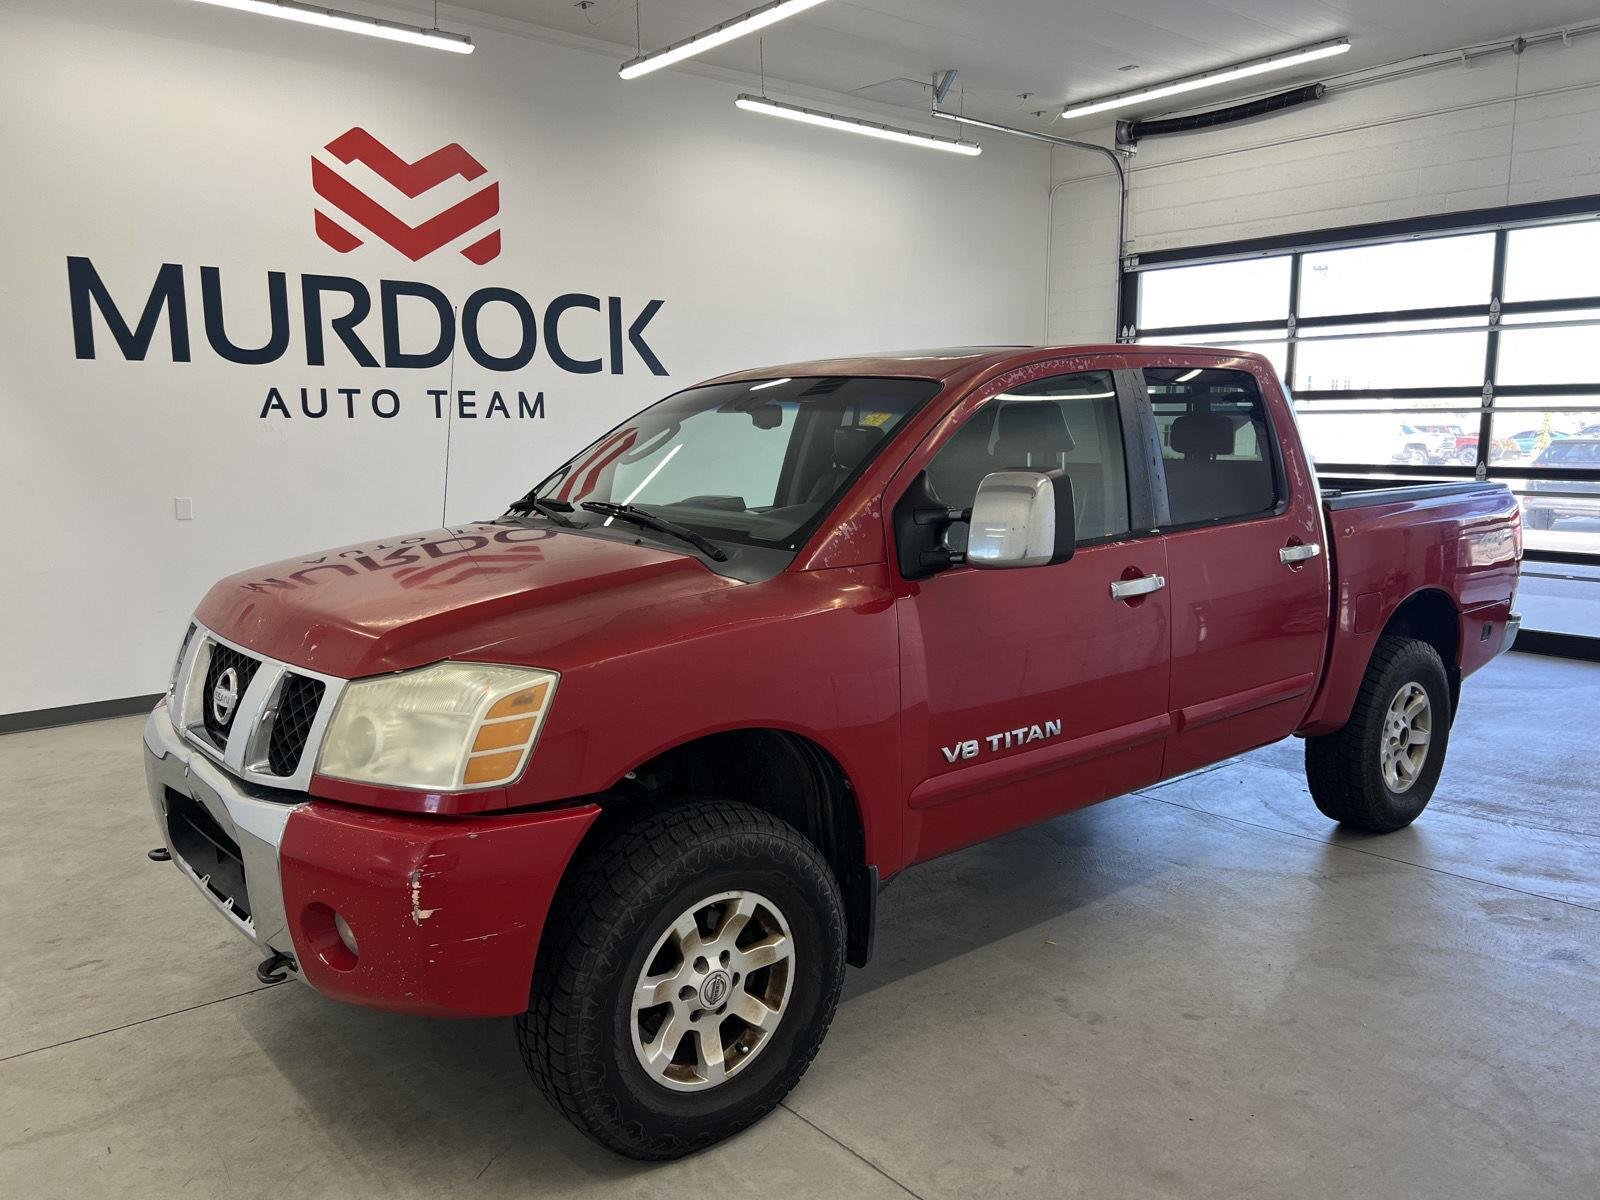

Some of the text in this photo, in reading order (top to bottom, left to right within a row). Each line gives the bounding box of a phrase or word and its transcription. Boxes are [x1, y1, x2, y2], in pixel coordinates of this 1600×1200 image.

[67, 256, 669, 376] MURDOCK
[260, 387, 545, 418] AUTO TEAM
[941, 719, 1062, 763] V8 TITAN
